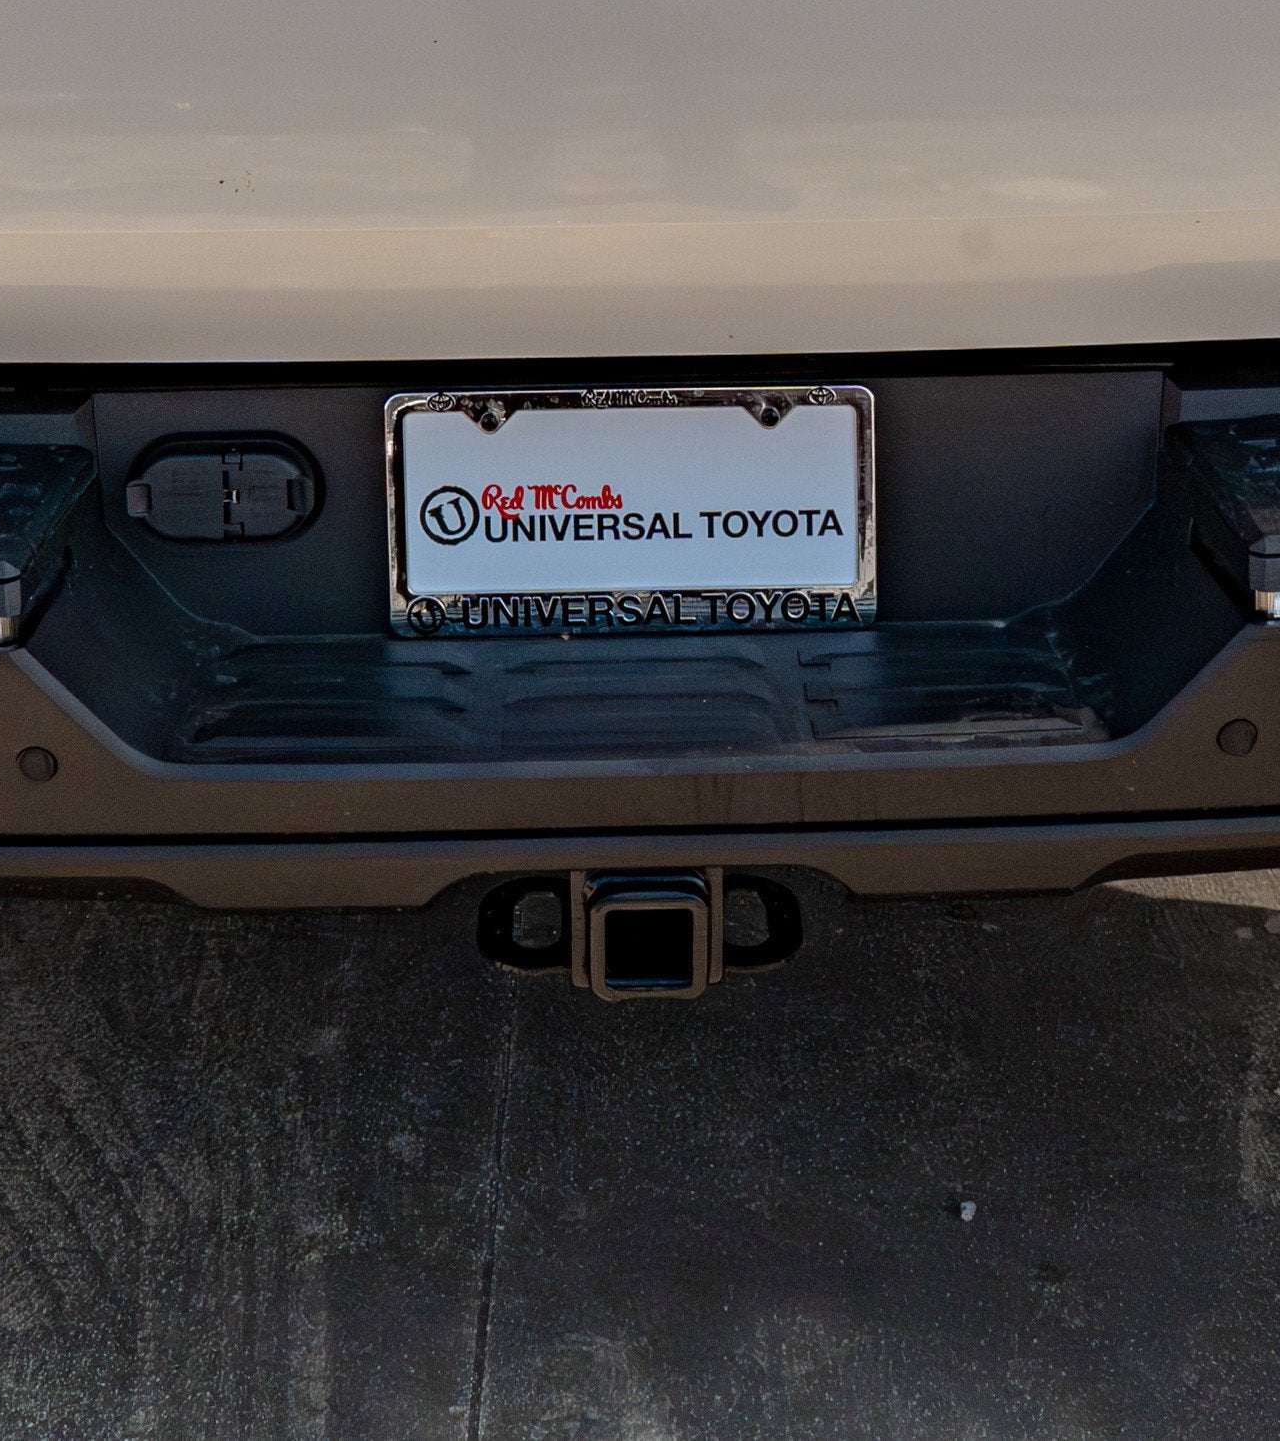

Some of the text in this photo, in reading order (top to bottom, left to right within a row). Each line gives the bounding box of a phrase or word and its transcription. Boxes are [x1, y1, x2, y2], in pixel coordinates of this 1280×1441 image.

[482, 484, 623, 520] Red McCombs
[484, 508, 844, 543] UNIVERSAL TOYOTA
[462, 590, 862, 630] UNIVERSAL TOYOTA
